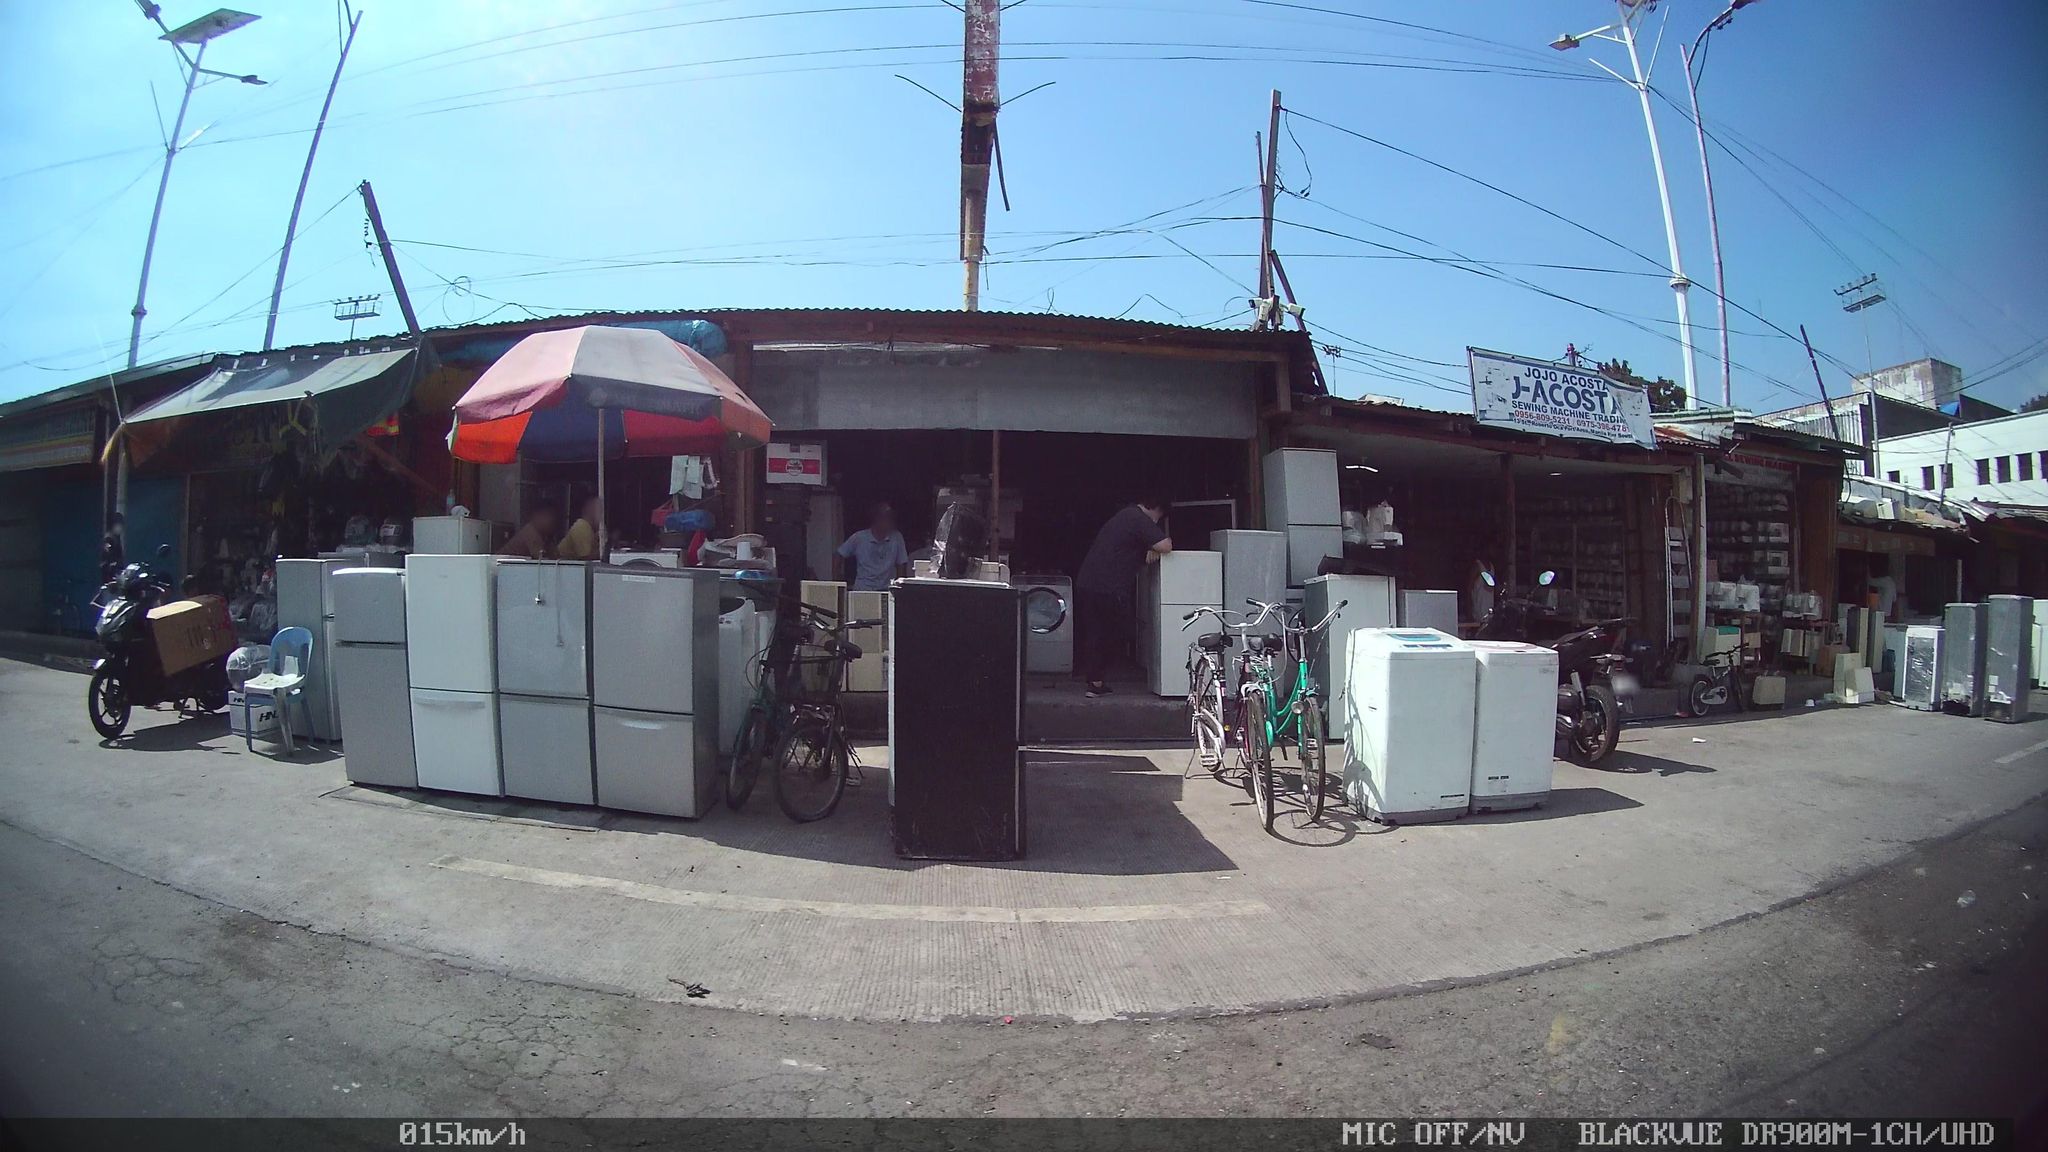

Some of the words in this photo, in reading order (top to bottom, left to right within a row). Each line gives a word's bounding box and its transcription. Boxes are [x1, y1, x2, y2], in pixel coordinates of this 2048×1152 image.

[1524, 367, 1557, 382] JOJO
[1561, 374, 1610, 392] ACOSTA
[1511, 400, 1548, 413] SEWING
[1550, 406, 1591, 420] MACHINE
[1592, 413, 1626, 424] TRADIN
